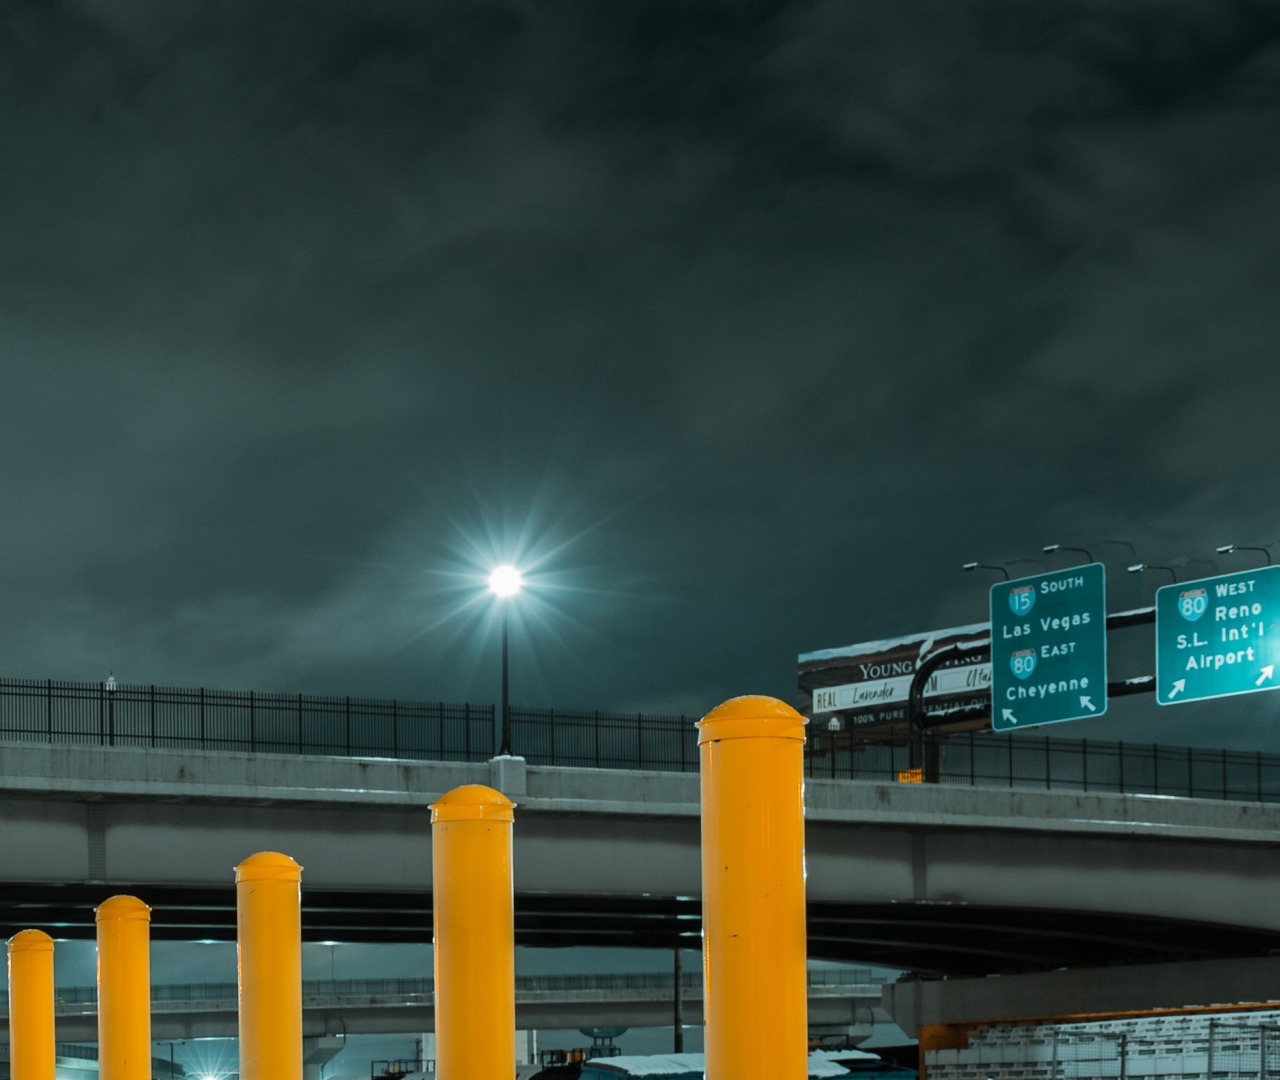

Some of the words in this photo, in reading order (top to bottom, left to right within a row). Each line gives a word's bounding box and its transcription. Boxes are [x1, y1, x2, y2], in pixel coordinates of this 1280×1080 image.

[1014, 592, 1030, 610] 15
[1040, 576, 1084, 594] SOUTH
[1182, 596, 1205, 615] 80
[1215, 580, 1256, 598] WEST
[1215, 603, 1262, 621] Reno
[1002, 624, 1031, 639] Las
[1040, 612, 1090, 631] Vegas
[1176, 632, 1208, 649] S.L.
[859, 661, 913, 680] YOUNG
[1014, 656, 1034, 674] 80
[1041, 642, 1076, 658] EAST
[1185, 646, 1255, 671] Airport
[817, 691, 837, 710] REAL
[852, 682, 895, 704] Lavender
[1006, 677, 1089, 700] Cheyenne
[853, 714, 875, 725] 100%
[880, 710, 905, 721] PURE
